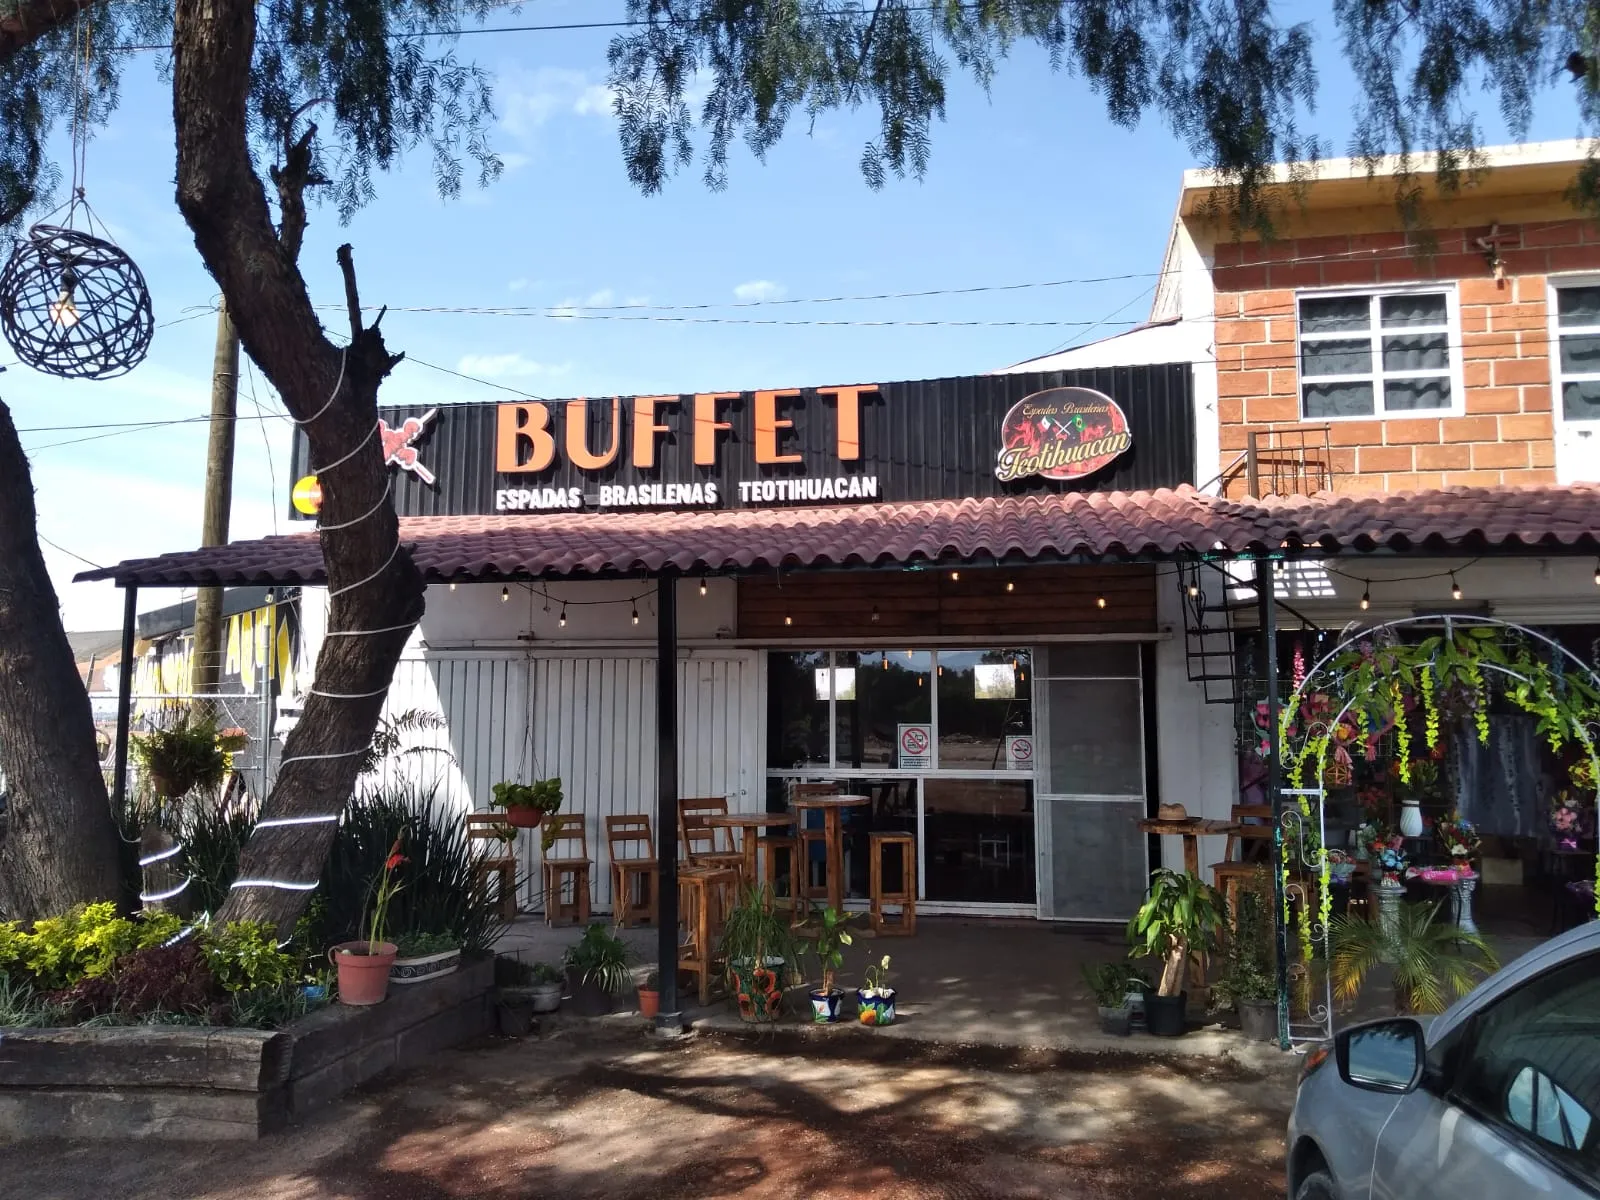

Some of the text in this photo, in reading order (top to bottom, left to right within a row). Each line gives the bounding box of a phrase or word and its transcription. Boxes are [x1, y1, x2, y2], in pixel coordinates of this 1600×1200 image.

[495, 384, 880, 474] BUFFET
[495, 476, 878, 510] ESPADAS BRASILENAS TEOTIHUACAN
